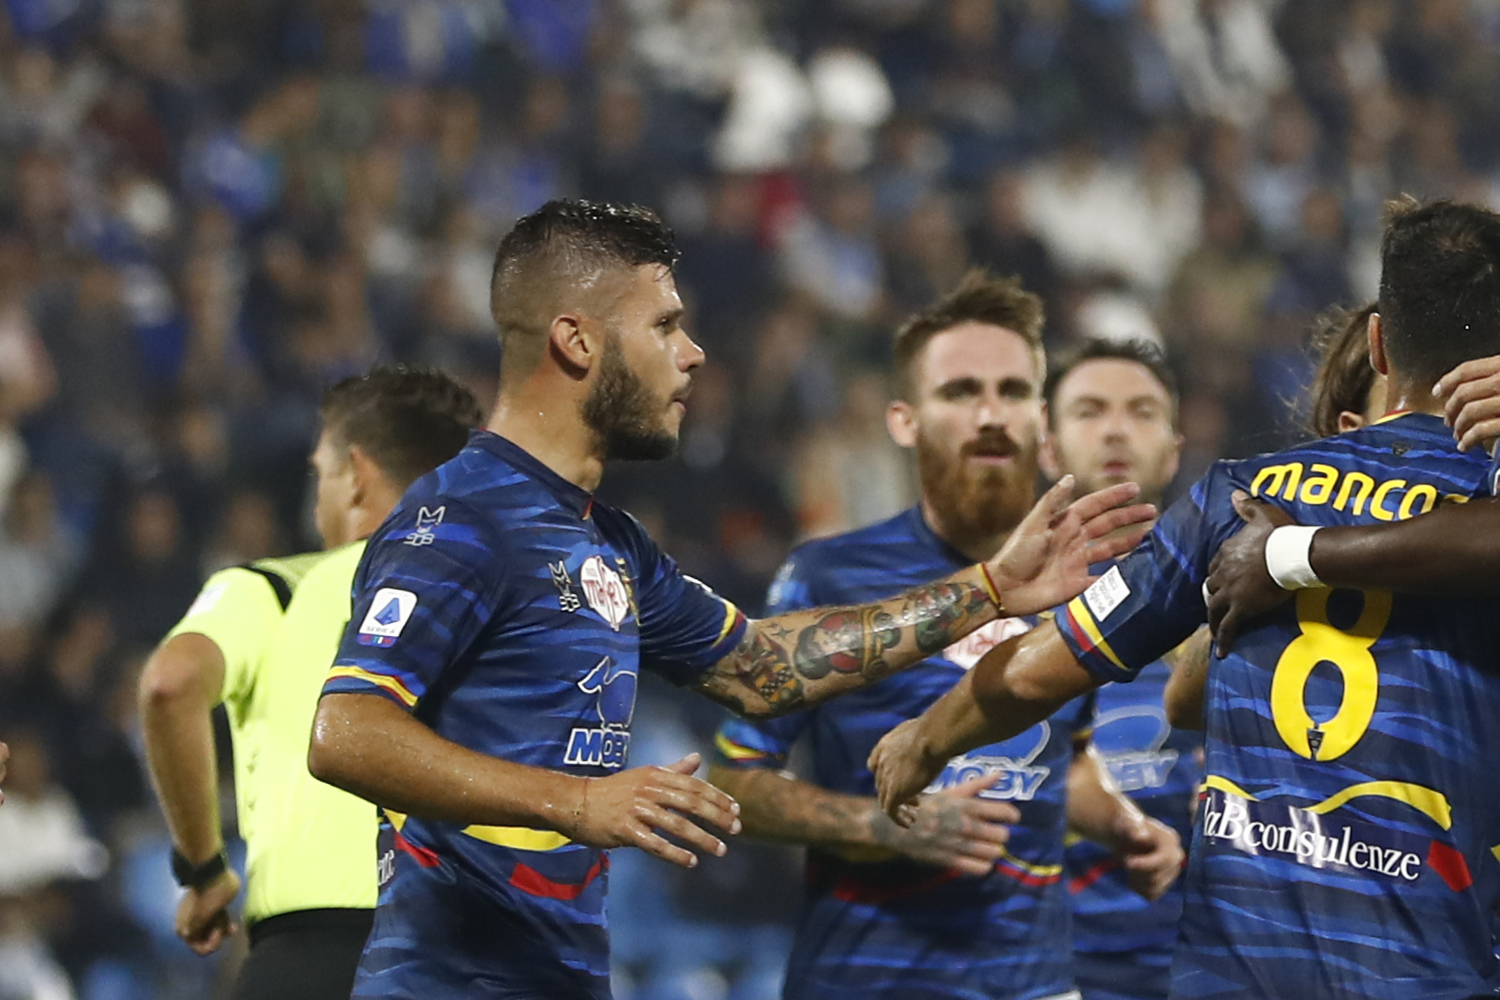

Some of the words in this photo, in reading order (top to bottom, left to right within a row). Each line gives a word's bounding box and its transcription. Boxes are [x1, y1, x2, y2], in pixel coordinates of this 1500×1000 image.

[1251, 462, 1471, 522] manco
[1270, 586, 1393, 763] 8
[562, 727, 631, 768] MOB
